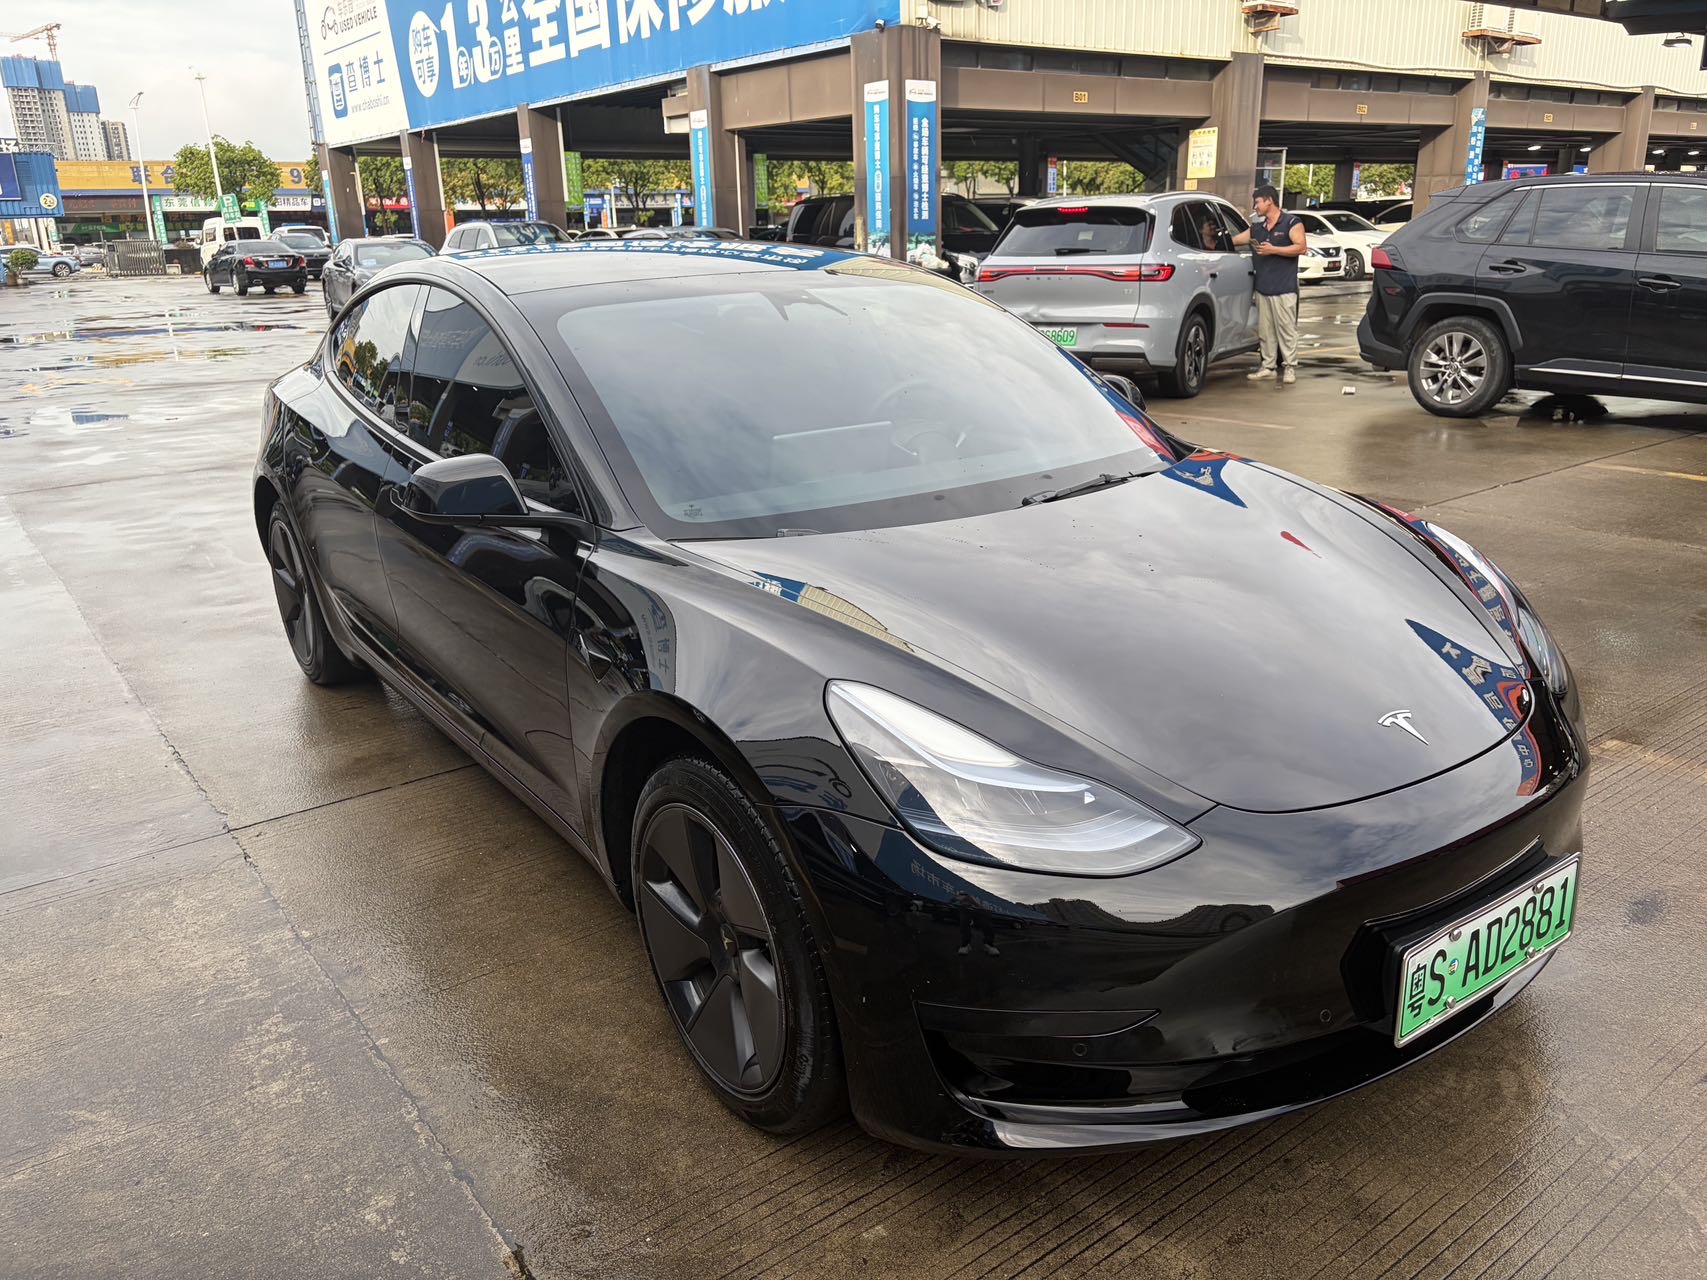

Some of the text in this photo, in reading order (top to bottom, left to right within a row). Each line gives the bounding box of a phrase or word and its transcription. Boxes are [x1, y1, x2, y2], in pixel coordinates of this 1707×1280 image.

[339, 16, 354, 32] USED
[354, 6, 378, 27] VEHICLE
[412, 24, 433, 55] 购车
[346, 50, 386, 93] 查博士
[415, 54, 437, 85] 可享
[289, 167, 303, 185] 9
[1041, 329, 1076, 343] 68609
[1461, 876, 1569, 988] AD2881
